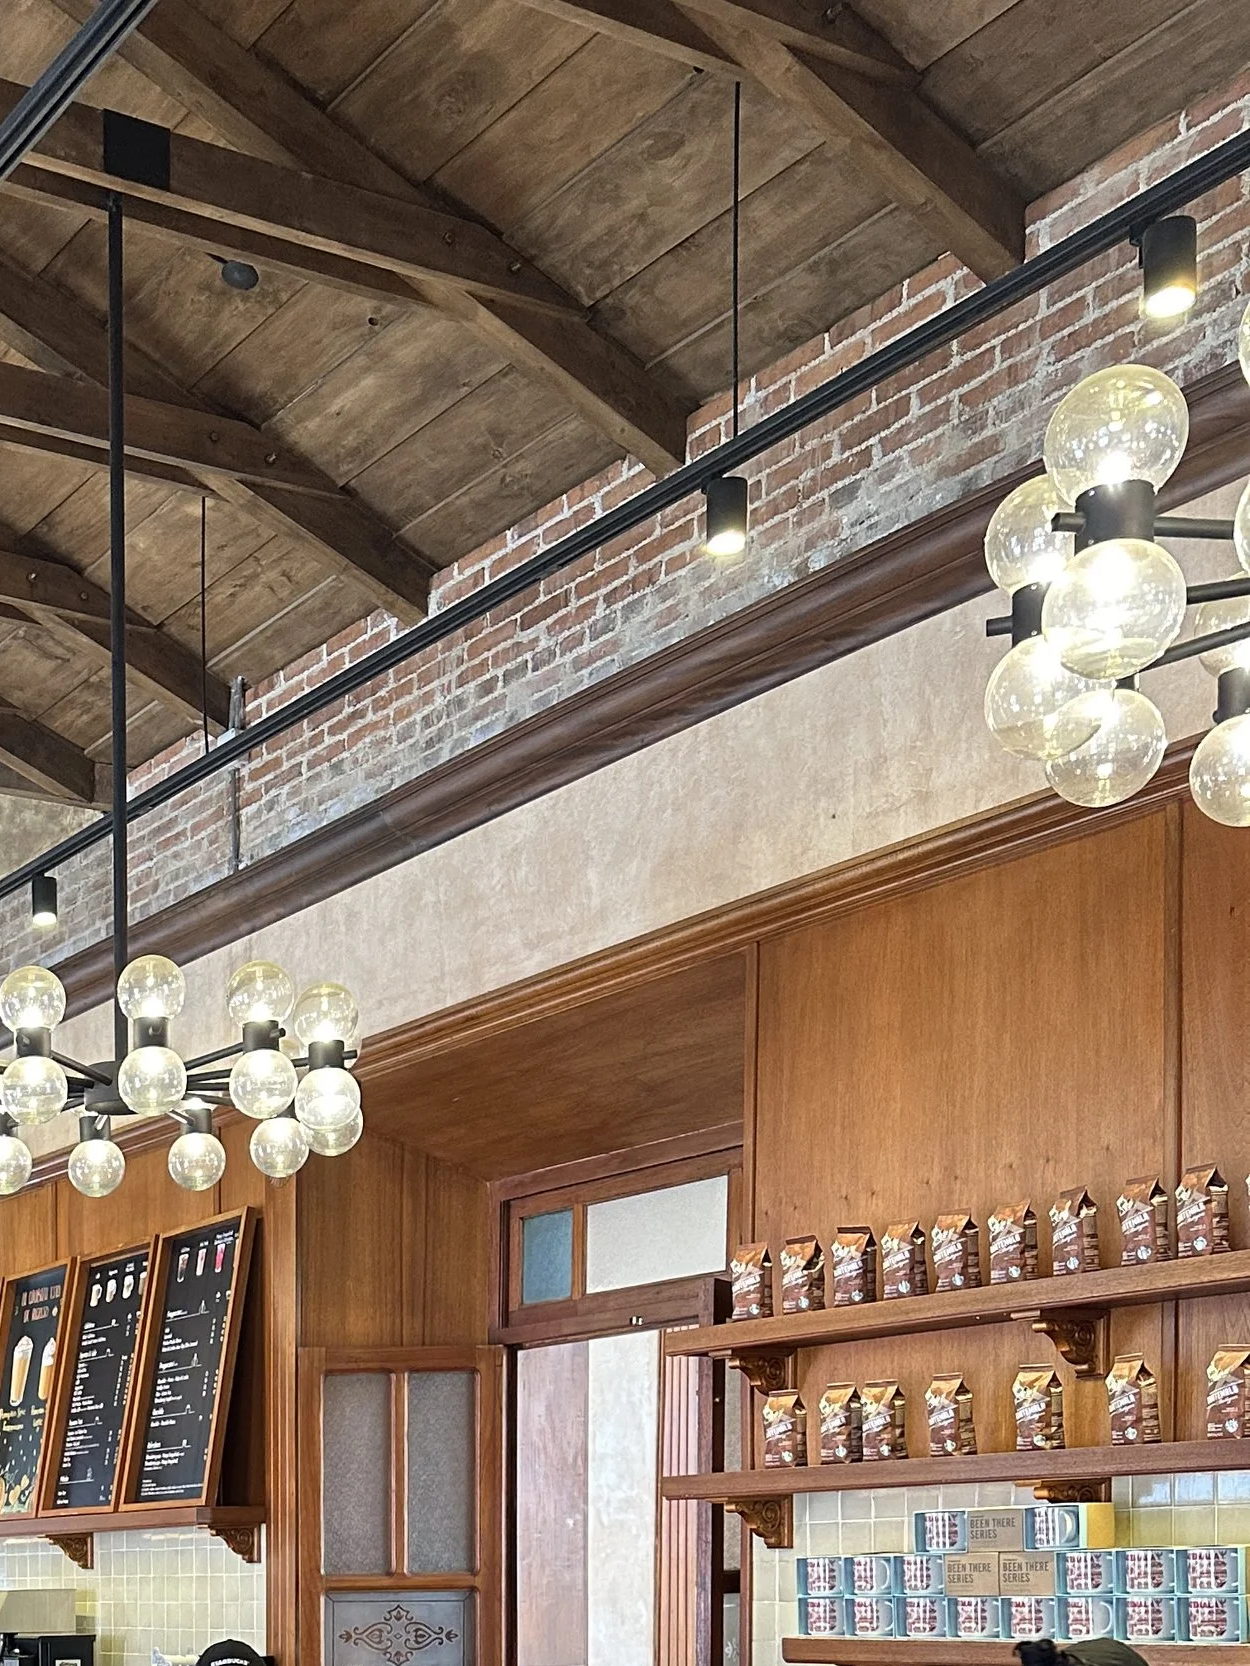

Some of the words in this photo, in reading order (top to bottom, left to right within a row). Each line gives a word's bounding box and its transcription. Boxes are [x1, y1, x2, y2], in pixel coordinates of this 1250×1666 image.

[970, 1518, 990, 1528] BEEN
[992, 1517, 1016, 1527] THERE
[970, 1529, 998, 1539] SERIES
[947, 1563, 967, 1573] BEEN
[968, 1562, 991, 1572] THERE
[1002, 1562, 1023, 1572] BEEN
[1025, 1561, 1049, 1571] THERE
[947, 1574, 974, 1584] SERIES
[1002, 1573, 1030, 1583] SERIES
